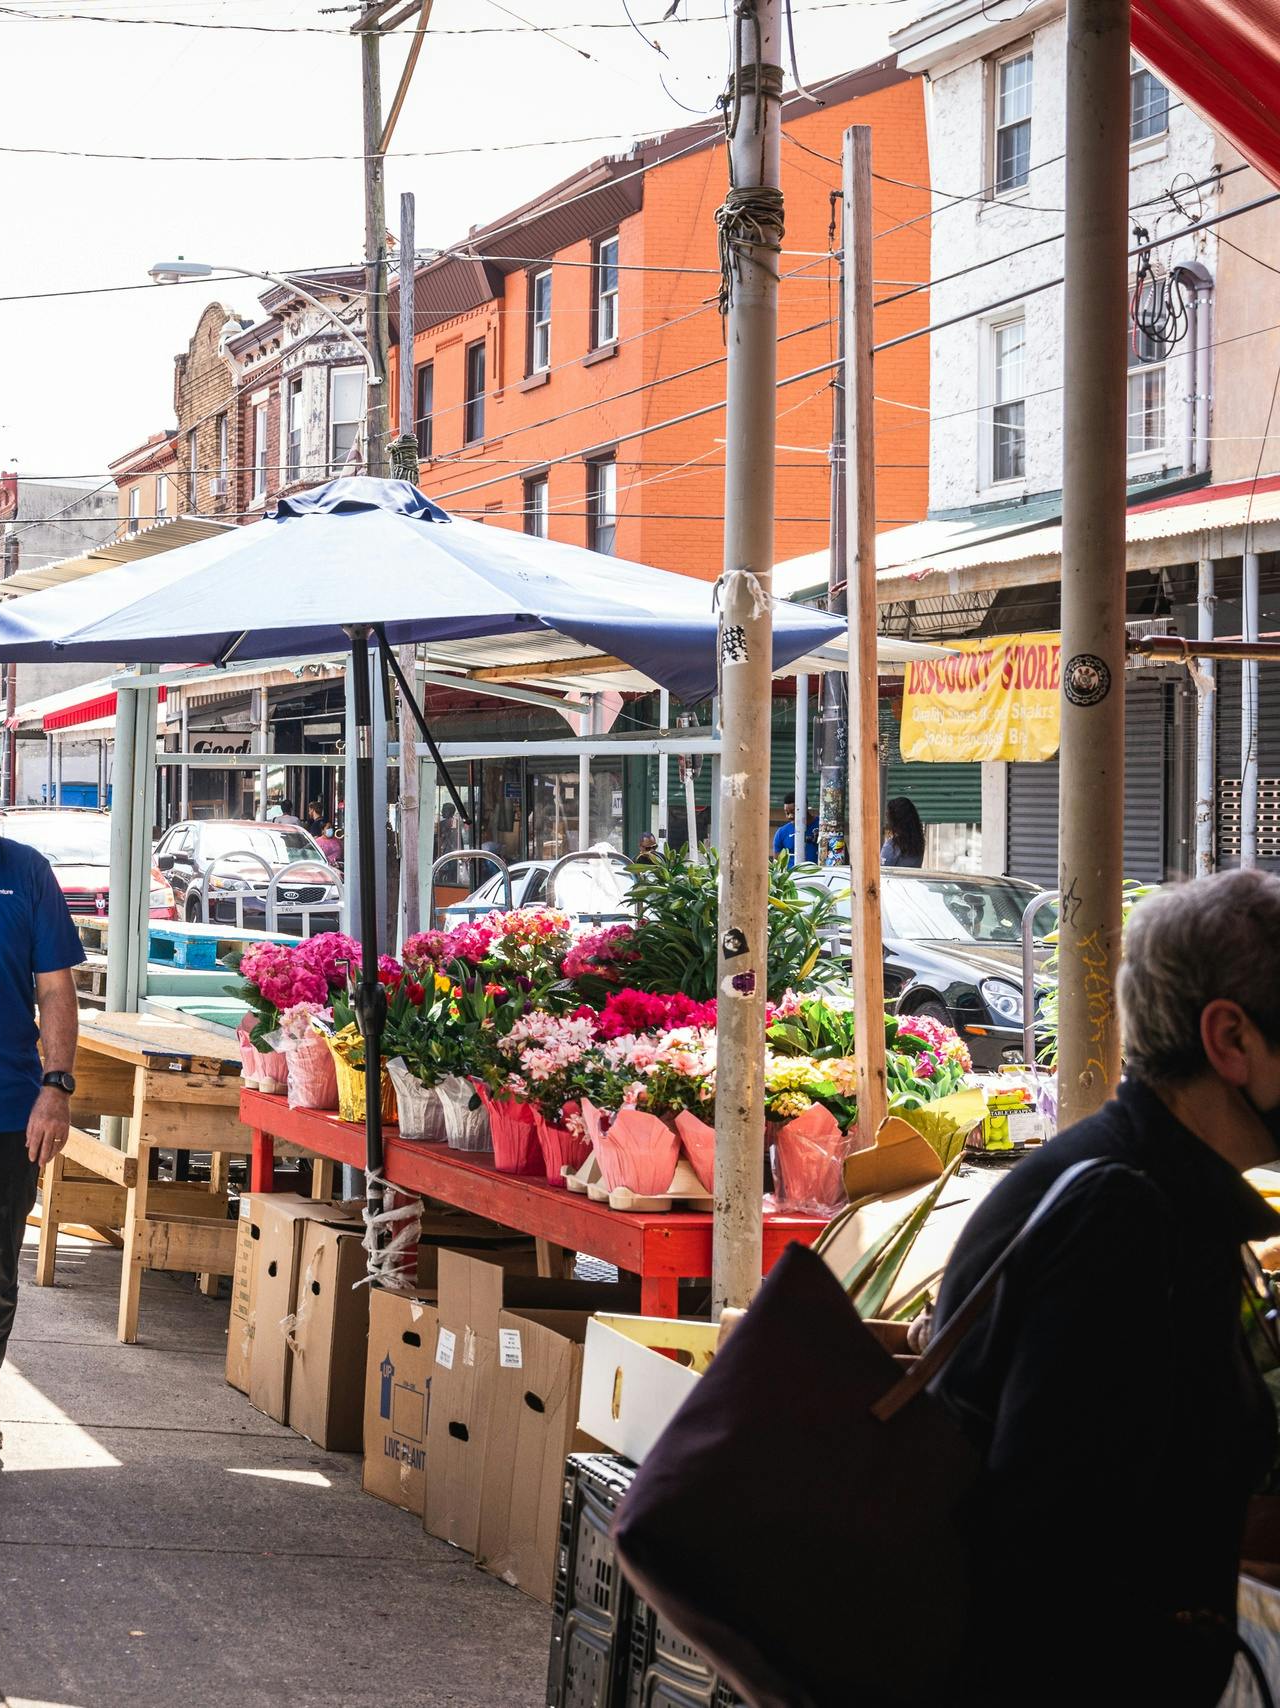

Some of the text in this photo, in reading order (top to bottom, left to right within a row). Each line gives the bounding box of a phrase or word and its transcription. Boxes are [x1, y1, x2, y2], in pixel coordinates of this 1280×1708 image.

[908, 648, 993, 696] DISCOUNT
[1001, 644, 1061, 691] STORE
[193, 739, 252, 755] Good
[382, 1364, 392, 1378] UP
[384, 1435, 400, 1460] LIVE
